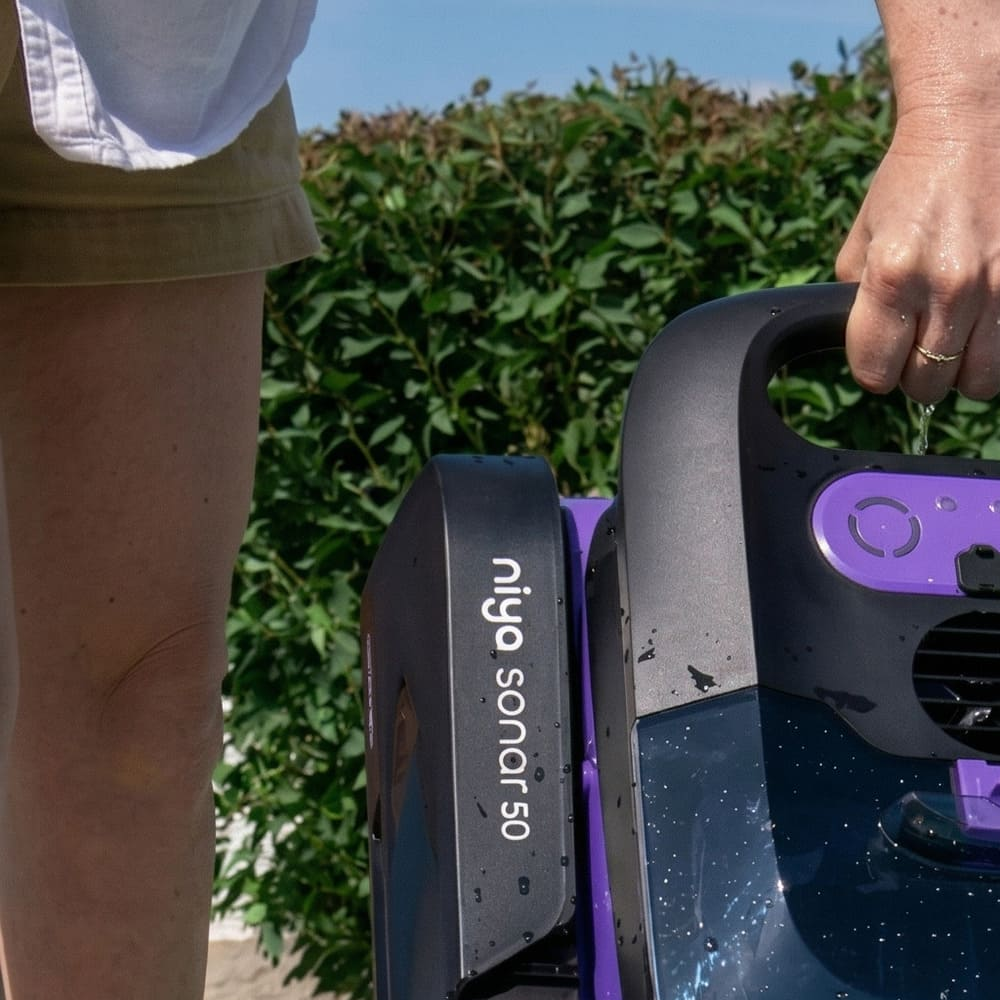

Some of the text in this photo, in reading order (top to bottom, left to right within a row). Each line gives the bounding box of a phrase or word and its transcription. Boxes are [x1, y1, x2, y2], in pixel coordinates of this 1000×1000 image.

[481, 557, 532, 841] niya sonar 50
